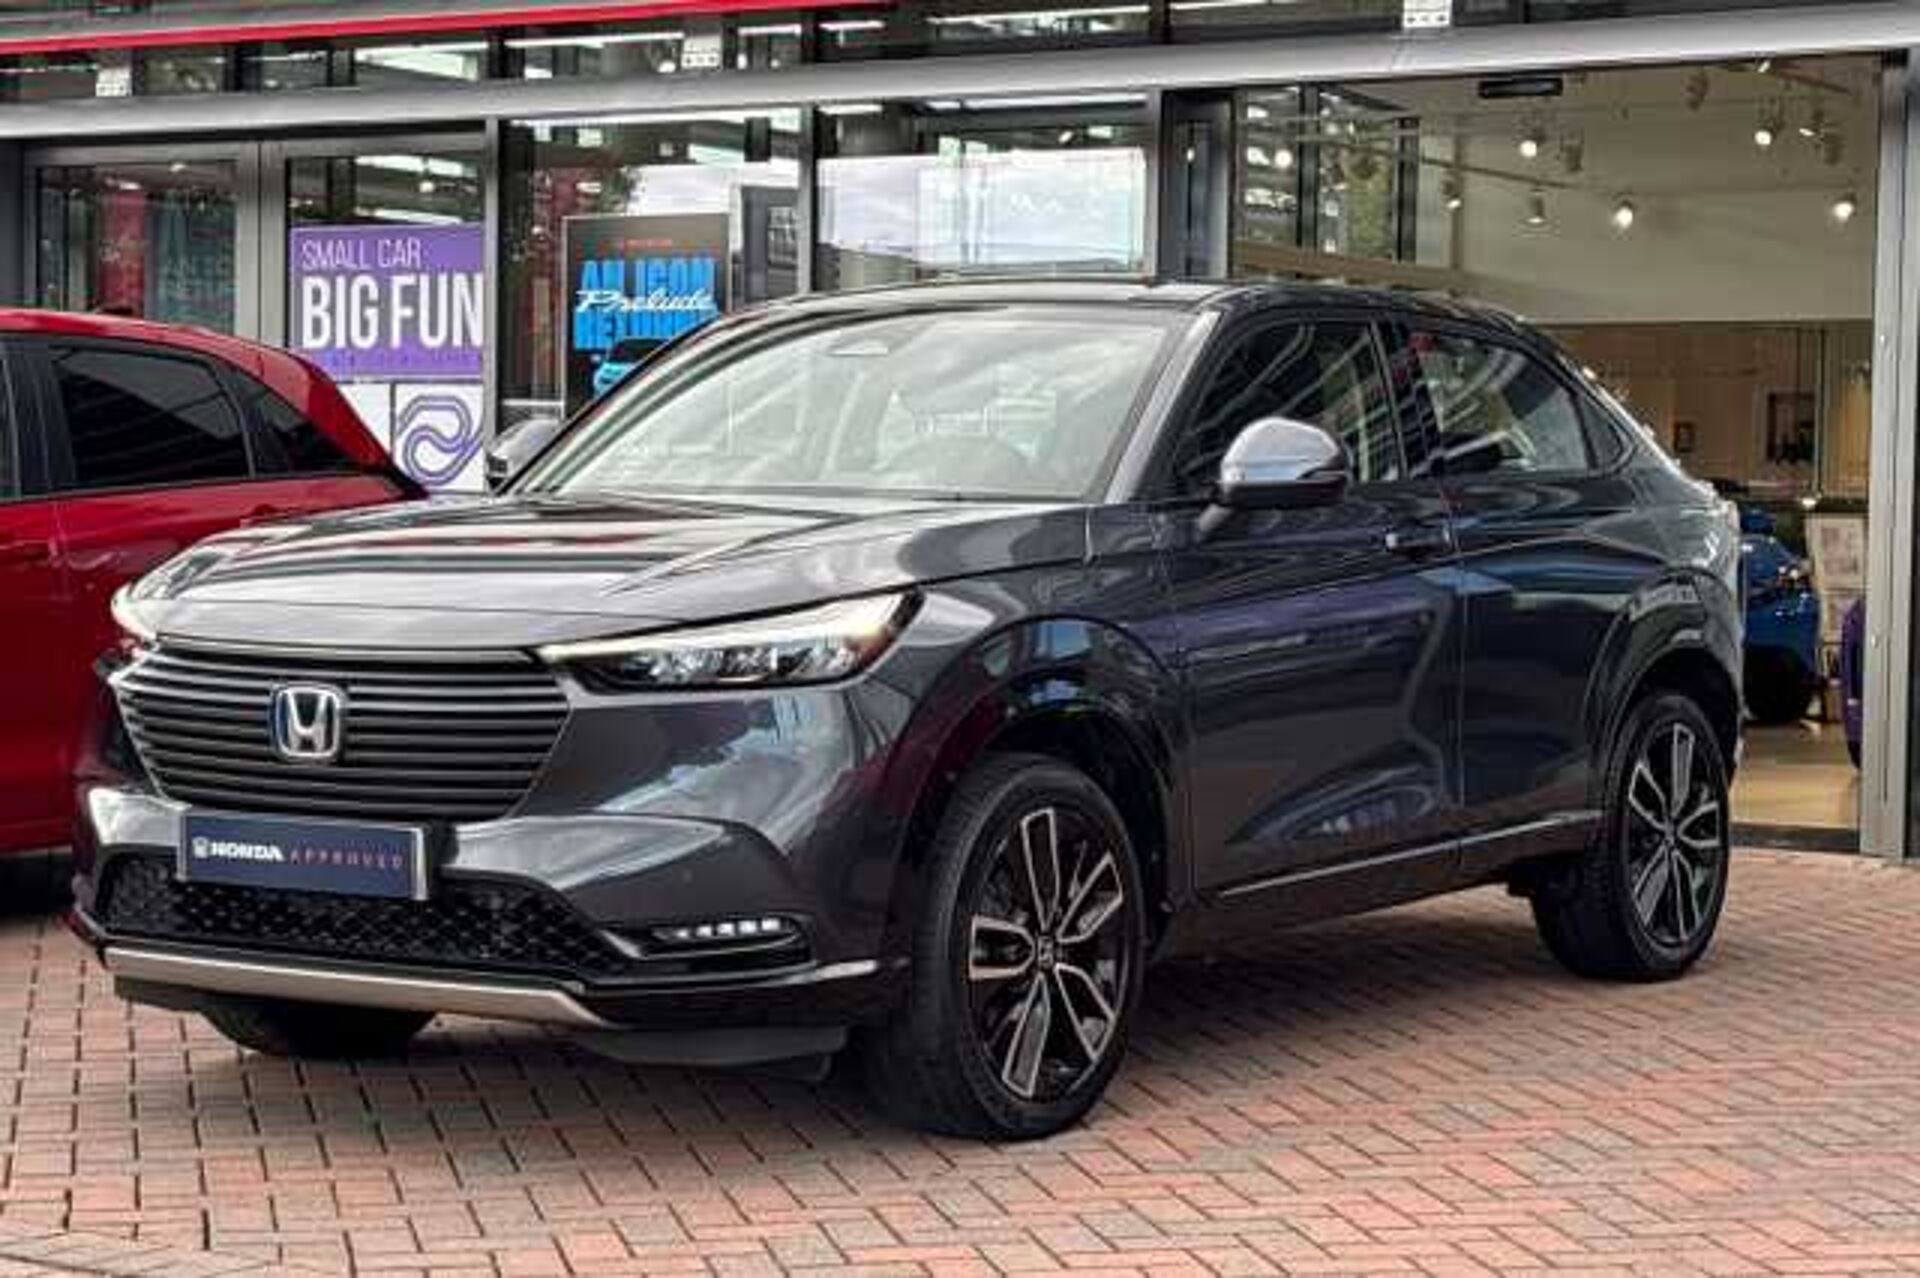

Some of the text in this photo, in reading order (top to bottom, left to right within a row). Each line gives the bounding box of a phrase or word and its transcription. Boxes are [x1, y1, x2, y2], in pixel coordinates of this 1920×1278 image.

[302, 237, 421, 270] SMALL CAR
[302, 274, 379, 350] BIG
[390, 271, 484, 349] FUN
[576, 287, 718, 314] Prelude
[211, 842, 402, 870] HONDA APPROVED
